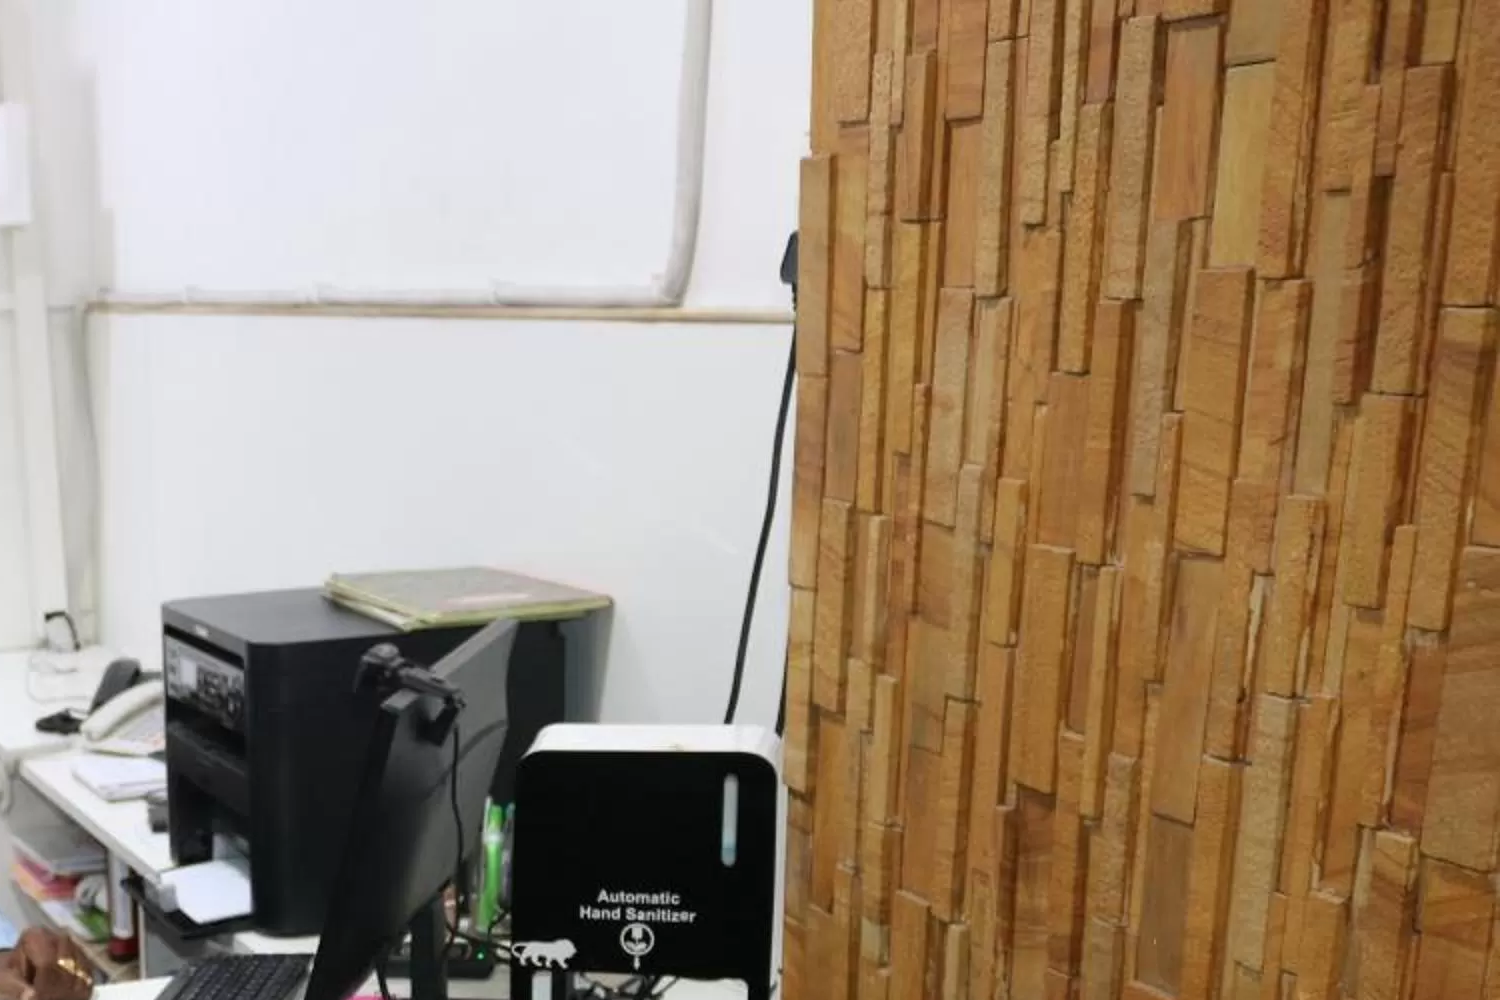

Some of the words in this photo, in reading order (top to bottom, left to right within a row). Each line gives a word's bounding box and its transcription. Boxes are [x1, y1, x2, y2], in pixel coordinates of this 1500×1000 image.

[597, 888, 681, 905] Automatic
[579, 905, 621, 920] Hand
[625, 907, 697, 924] Sanitizer
